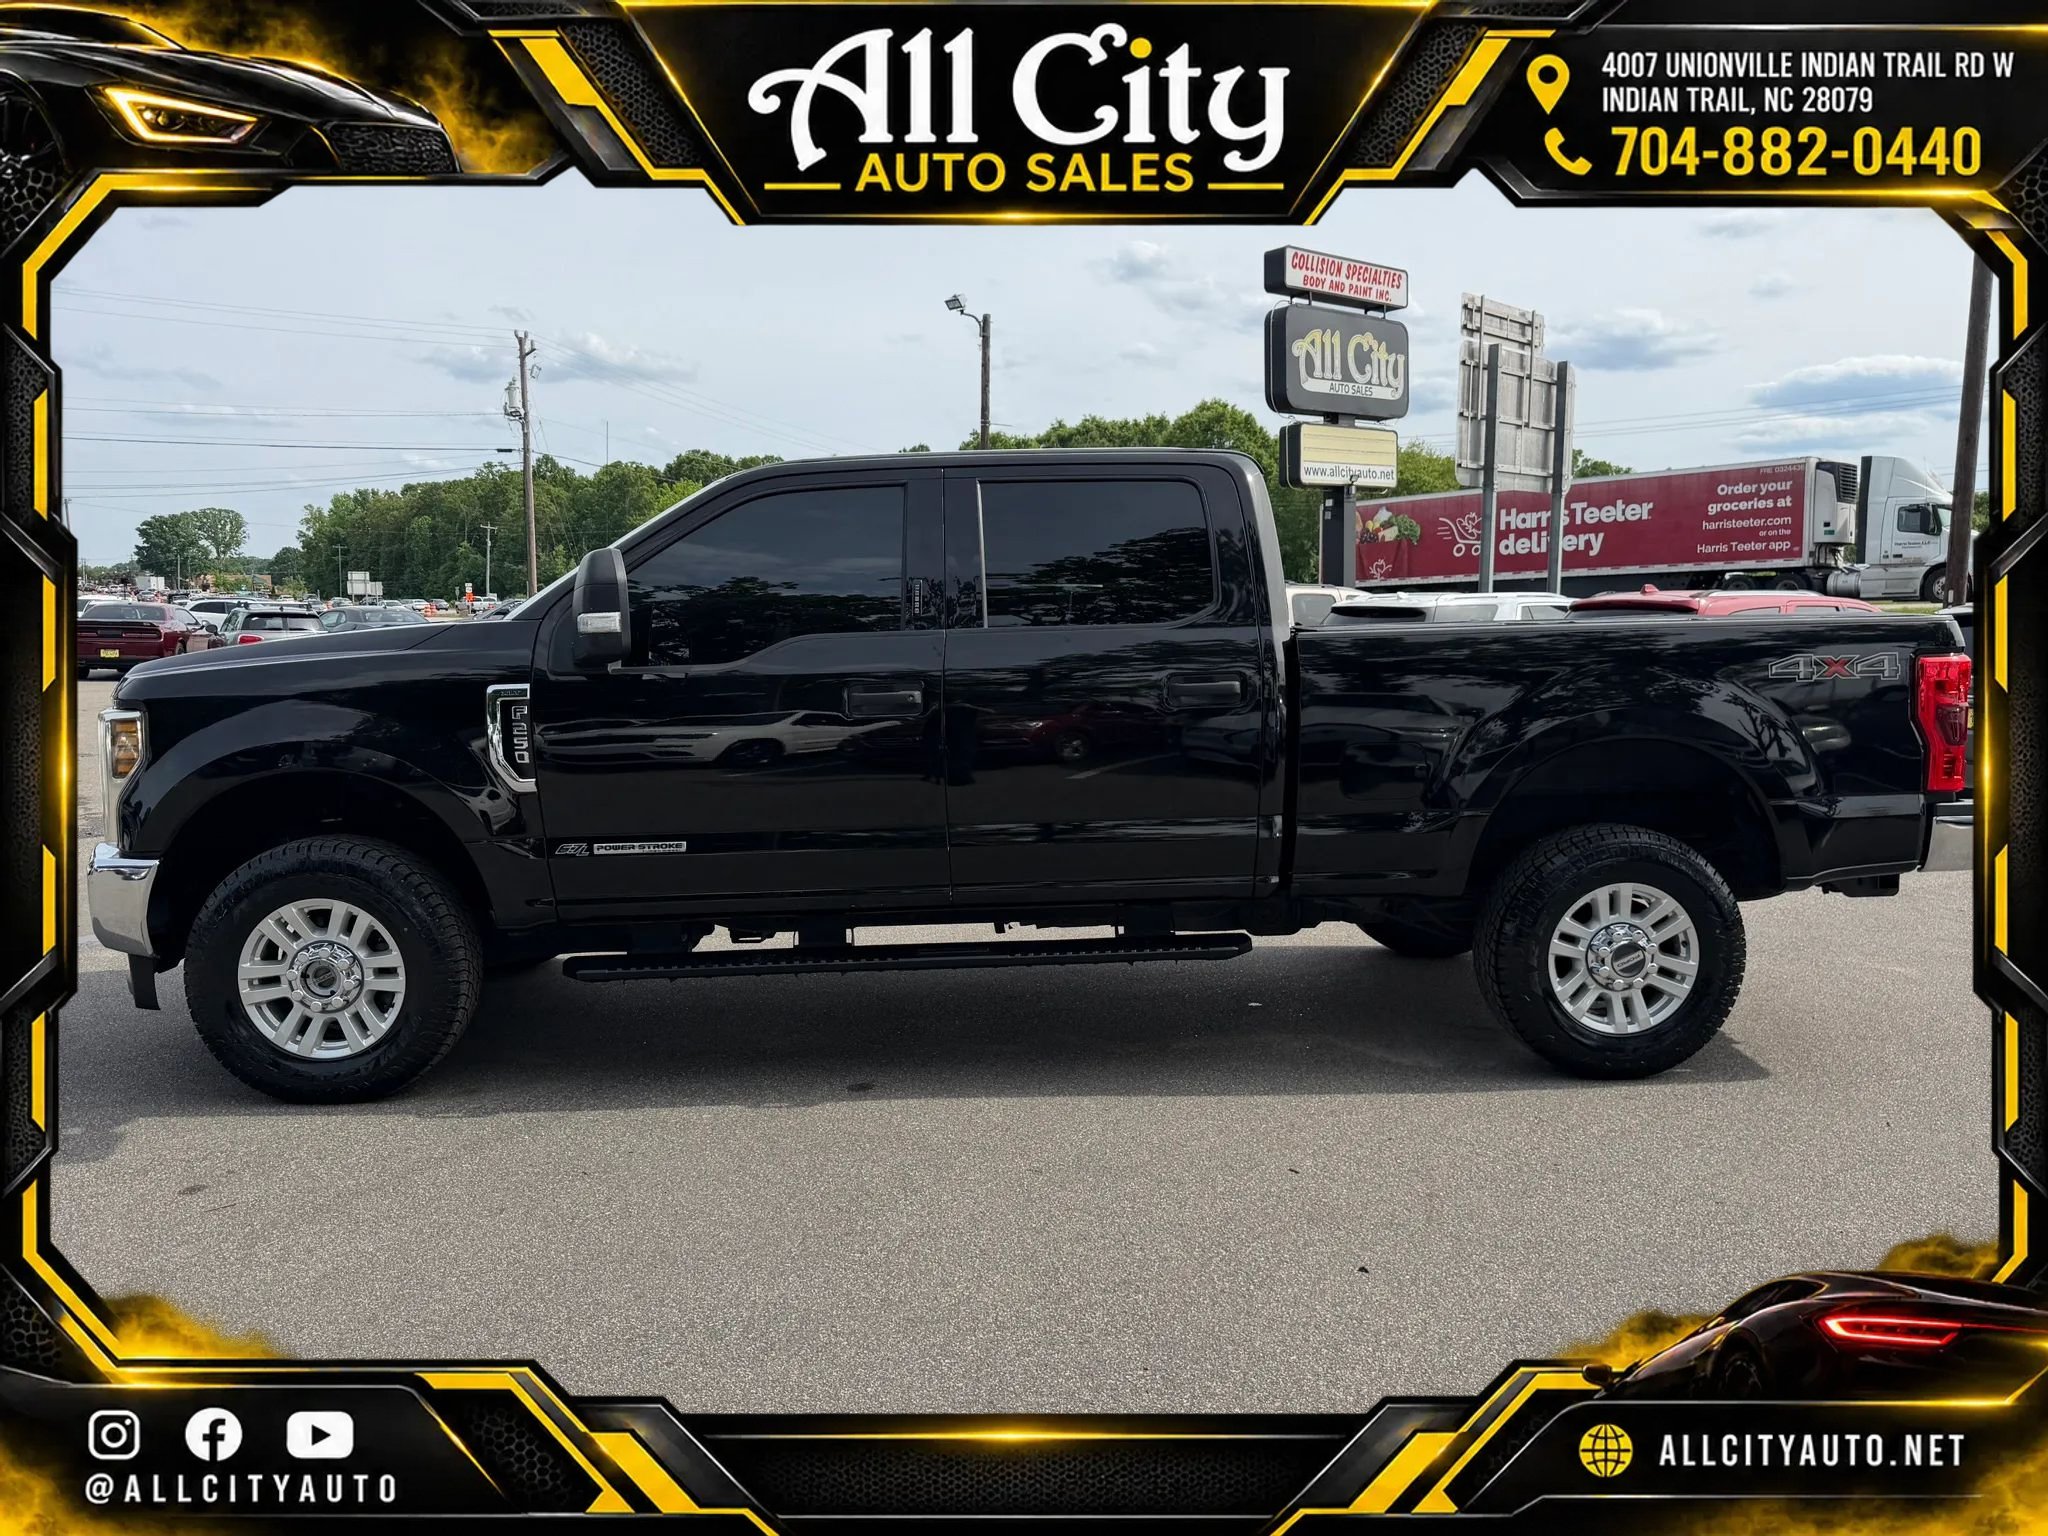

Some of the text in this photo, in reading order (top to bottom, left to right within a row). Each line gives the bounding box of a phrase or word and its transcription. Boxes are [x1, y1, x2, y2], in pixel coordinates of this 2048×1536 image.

[1291, 252, 1403, 289] COLLISION SPECIALTIES
[1303, 275, 1392, 302] BODY AND PAINT INC.
[1292, 329, 1405, 397] All City
[1329, 383, 1373, 397] AUTO SALES
[1717, 480, 1793, 495] Order your
[1708, 495, 1792, 515] groceries at
[1499, 499, 1654, 531] Harrs Teeter
[1702, 516, 1792, 530] harristeeter.com
[1778, 528, 1791, 536] the
[1499, 531, 1604, 556] deliery
[1697, 543, 1728, 554] Harris
[1730, 541, 1767, 551] Teeter
[1768, 540, 1791, 552] app
[596, 844, 636, 852] POWER
[638, 842, 683, 851] STROKE
